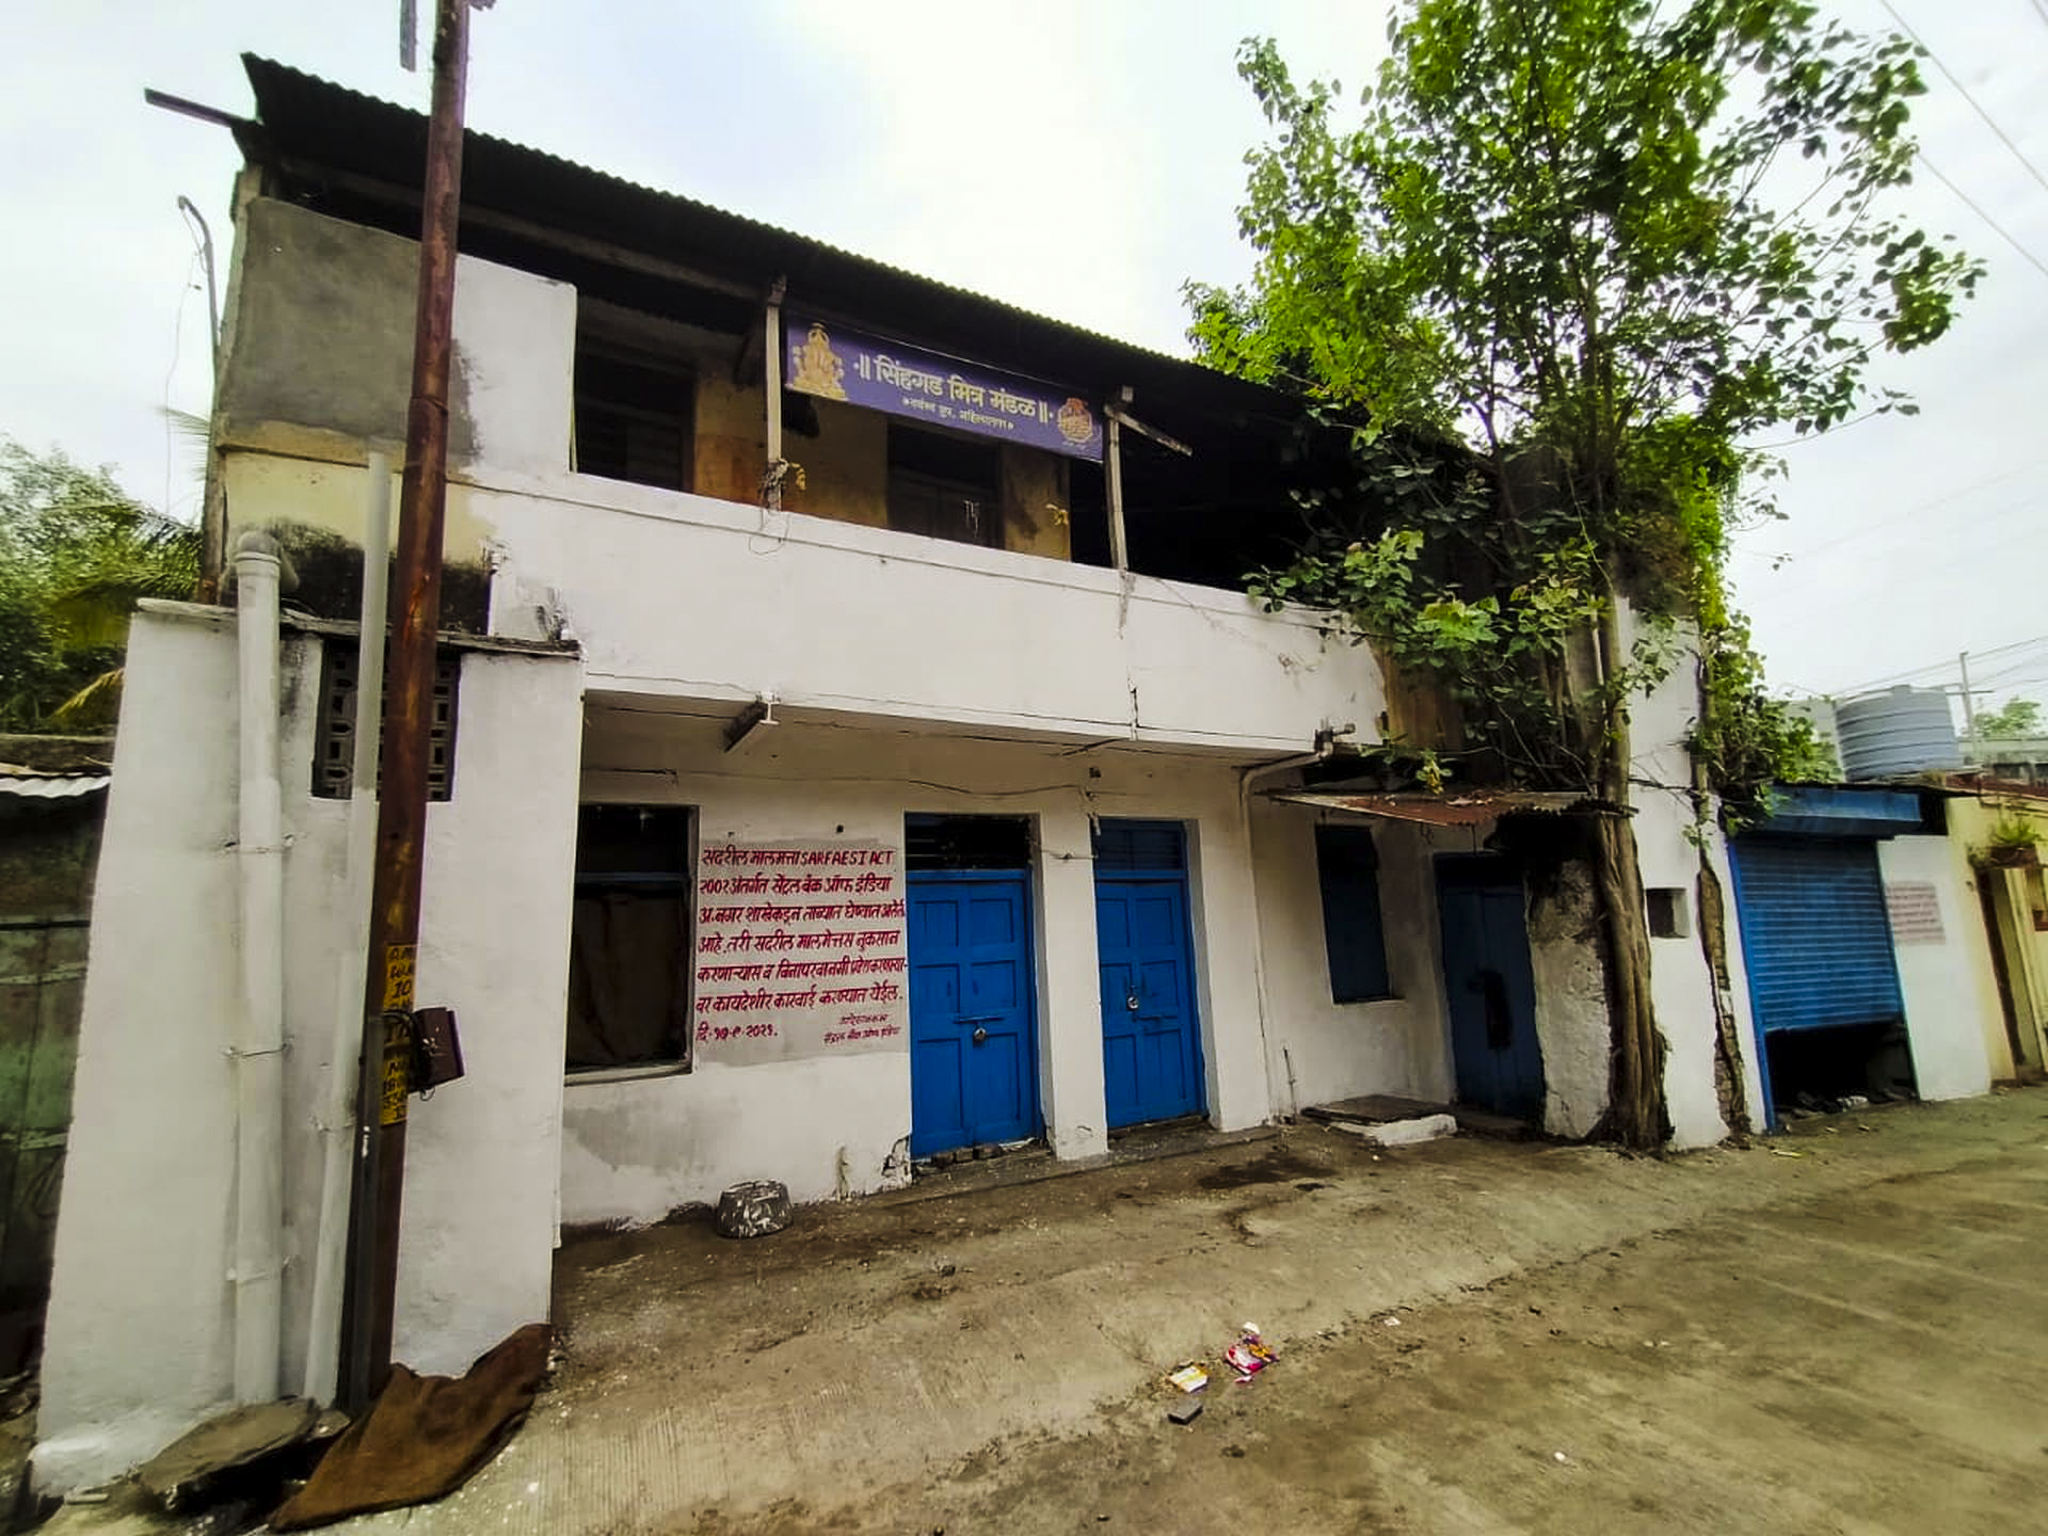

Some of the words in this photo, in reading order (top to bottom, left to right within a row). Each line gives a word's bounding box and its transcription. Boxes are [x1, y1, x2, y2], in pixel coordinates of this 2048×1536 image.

[875, 355, 943, 396] सिंहगड
[948, 375, 983, 407] मित्र
[989, 387, 1036, 417] मंडळ
[702, 844, 748, 866] सदरील
[801, 850, 867, 866] SARFAESI
[869, 851, 895, 865] ACT
[855, 872, 893, 893] इंडिया
[727, 929, 753, 951] तरी
[754, 929, 796, 951] सदरील
[856, 930, 901, 952] नुकसान
